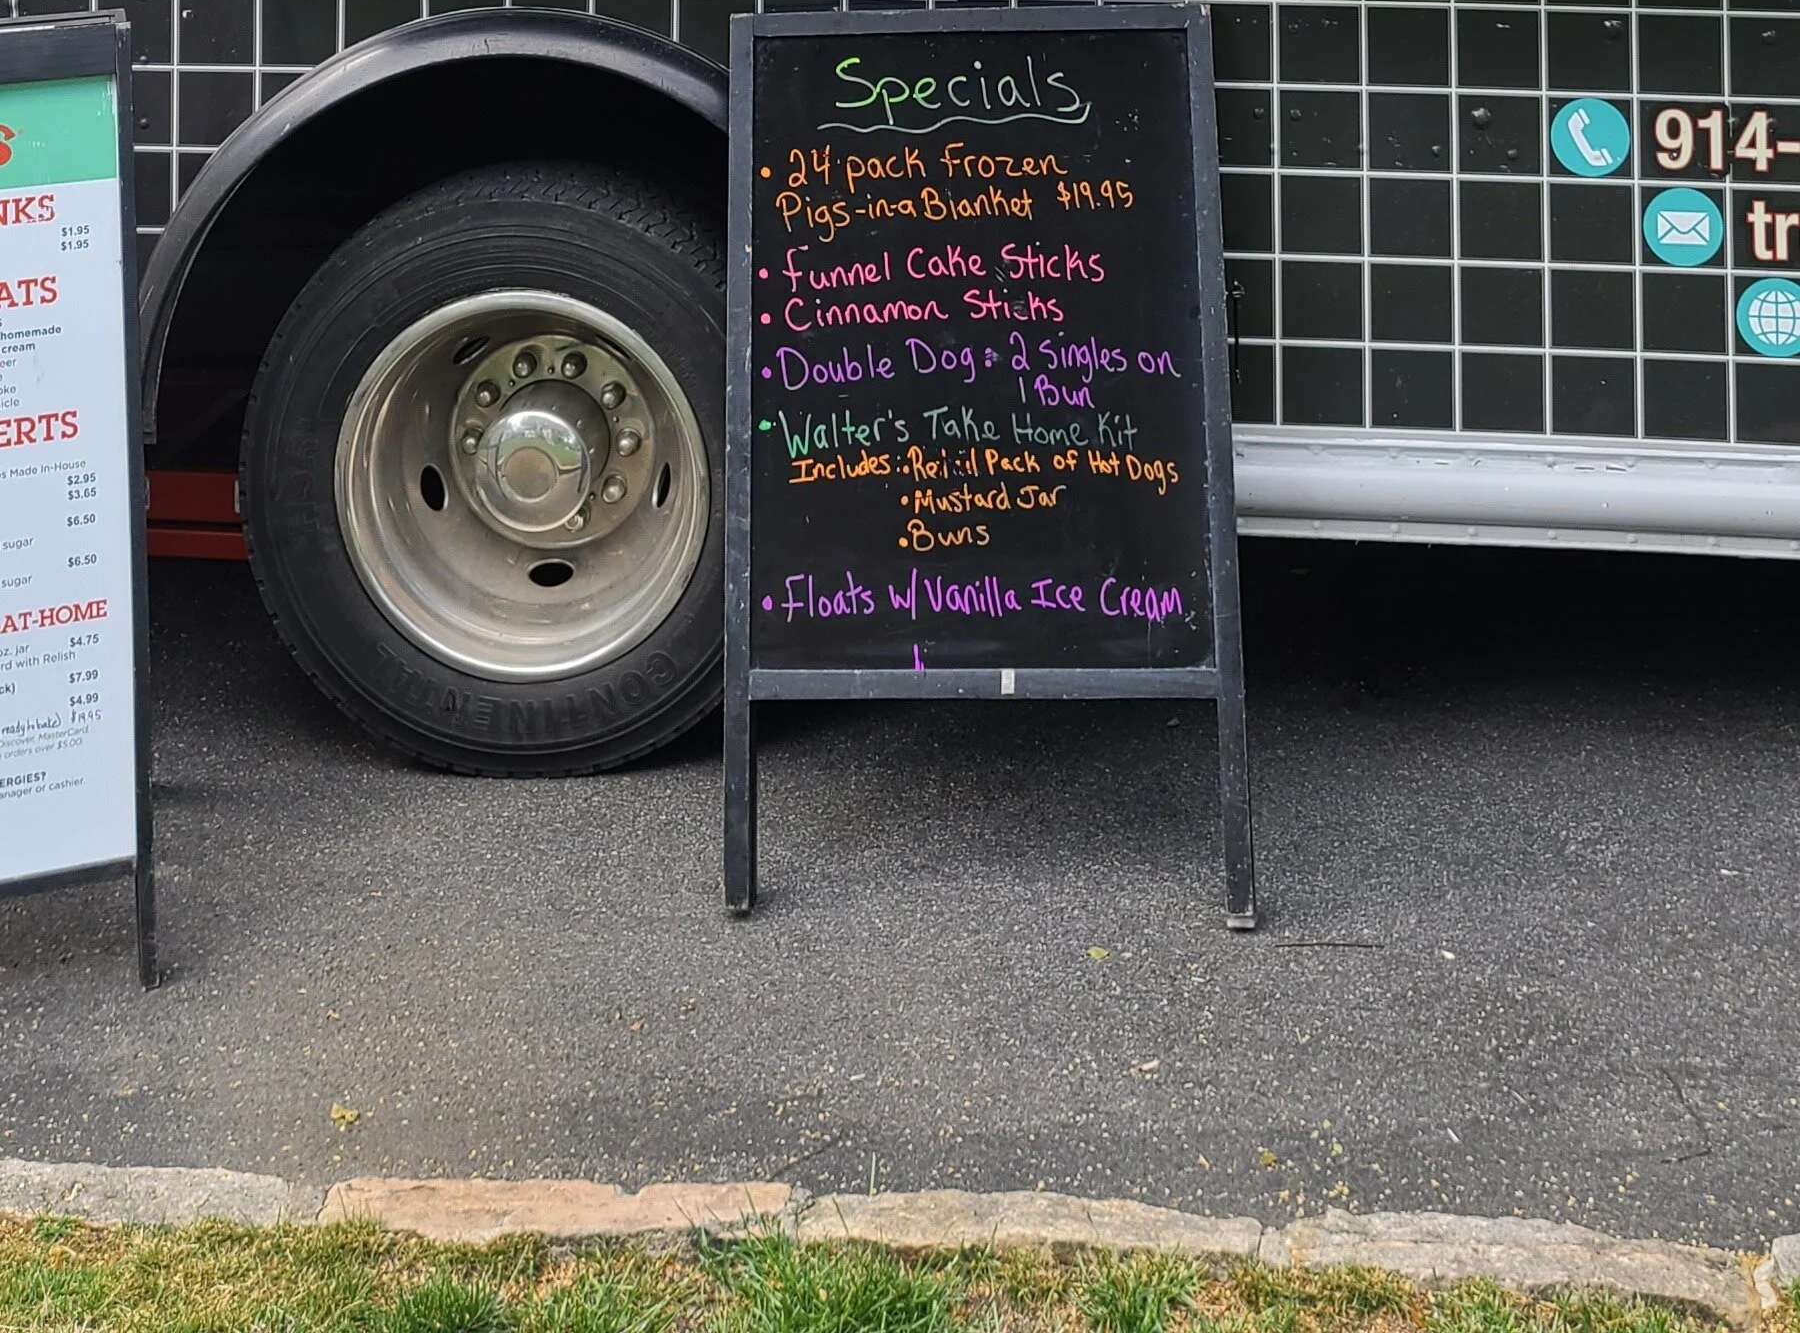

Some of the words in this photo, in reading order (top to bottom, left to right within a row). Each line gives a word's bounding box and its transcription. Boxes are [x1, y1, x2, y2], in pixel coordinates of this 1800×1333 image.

[835, 55, 1083, 125] Specials
[1653, 107, 1800, 173] 914-
[788, 144, 831, 187] 24
[846, 147, 927, 193] pack
[939, 142, 1069, 181] Frozen
[1056, 180, 1135, 213] $19.95
[61, 224, 90, 237] $1.95
[61, 238, 90, 251] $1.95
[781, 244, 891, 293] Funnel
[906, 245, 987, 280] Cake
[1000, 241, 1105, 284] Sticks
[783, 296, 949, 332] Cinnamon
[963, 289, 1065, 322] Sticks
[1, 342, 36, 354] cream
[775, 345, 895, 391] Double
[1009, 332, 1032, 370] 2
[1136, 349, 1182, 378] on
[1016, 376, 1027, 404] 1
[1033, 376, 1096, 409] Bun
[778, 408, 911, 459] Walter's
[923, 404, 1001, 443] Take
[1010, 413, 1090, 447] Home
[1097, 411, 1139, 450] Kit
[10, 465, 38, 479] Made
[40, 460, 87, 474] In-House
[67, 472, 97, 486] $2.95
[985, 447, 1041, 477] Pack
[1052, 449, 1079, 471] of
[1088, 450, 1122, 478] Hot
[1126, 456, 1180, 496] Dogs
[67, 487, 97, 501] $3.65
[912, 480, 1011, 514] Mustard
[1016, 483, 1068, 509] Jar
[67, 513, 96, 527] $6.50
[2, 537, 34, 551] sugar
[909, 519, 991, 552] Buns
[67, 553, 97, 568] $6.50
[1, 575, 33, 589] sugar
[781, 571, 876, 623] Floats
[888, 567, 918, 620] w/
[923, 576, 1022, 618] Vanilla
[1030, 578, 1087, 613] Ice
[1099, 577, 1184, 622] Cream
[15, 644, 30, 657] jar
[69, 633, 99, 649] $4.75
[16, 656, 40, 669] with
[43, 650, 76, 665] Relish
[69, 669, 99, 684] $7.99
[370, 641, 680, 733] CONTINENTAL
[69, 693, 99, 707] $4.99
